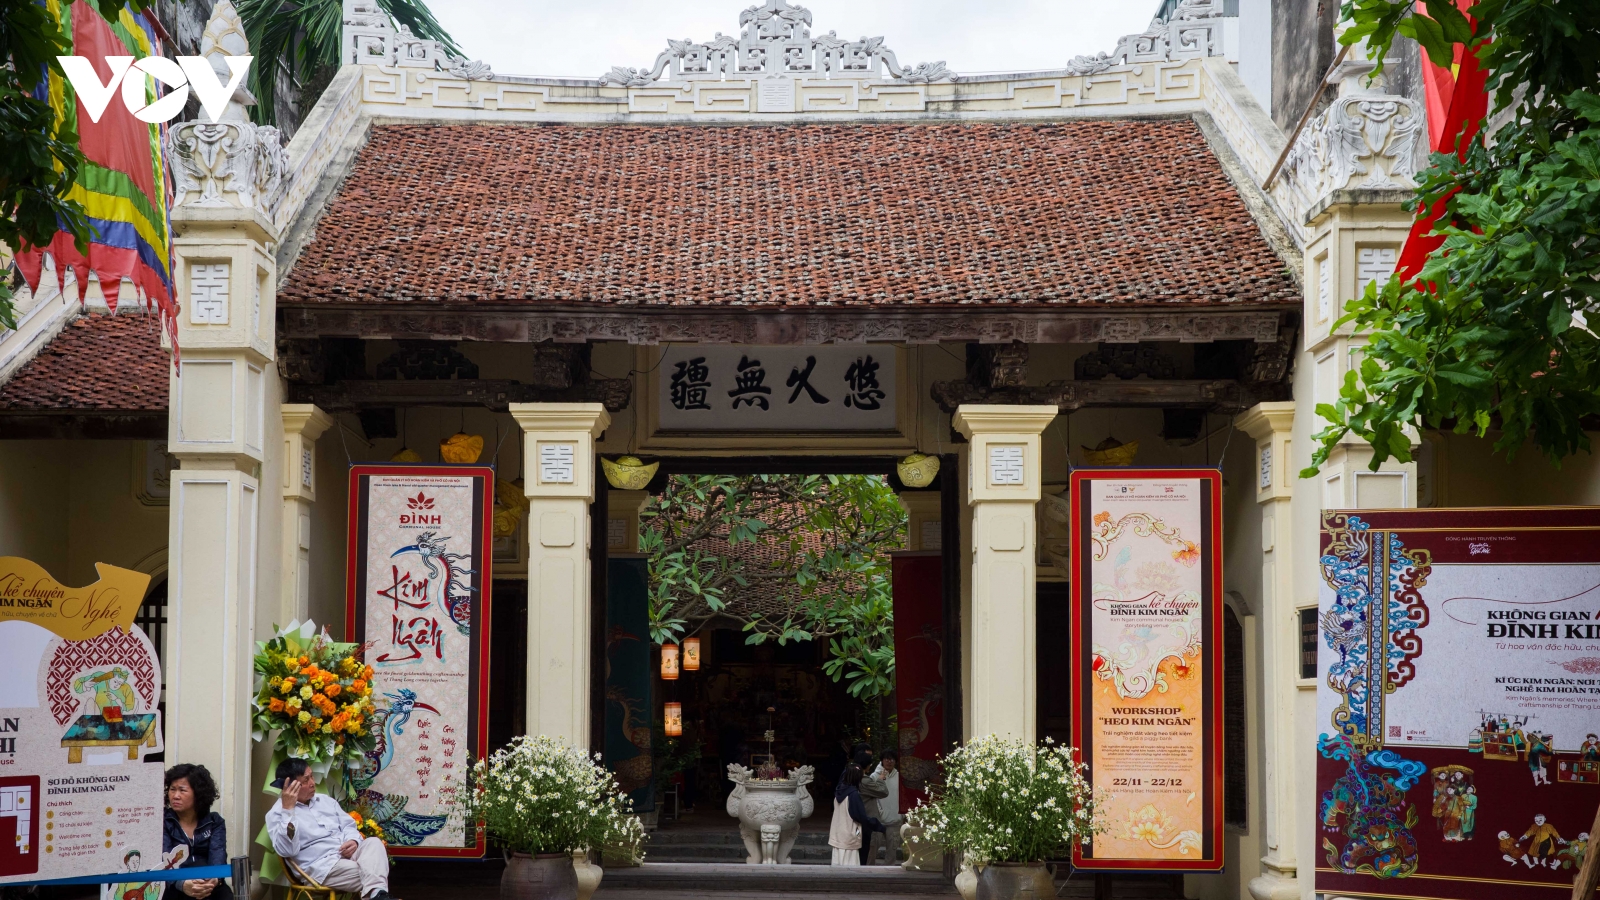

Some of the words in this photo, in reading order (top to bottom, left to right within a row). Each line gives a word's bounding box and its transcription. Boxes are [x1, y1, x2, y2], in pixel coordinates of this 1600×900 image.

[399, 512, 441, 524] ĐÌNH
[1487, 609, 1546, 620] KHÔNG
[1549, 612, 1591, 620] GIAN
[1565, 624, 1600, 639] KI
[1113, 778, 1141, 786] 22/11
[1151, 778, 1182, 787] 22/12
